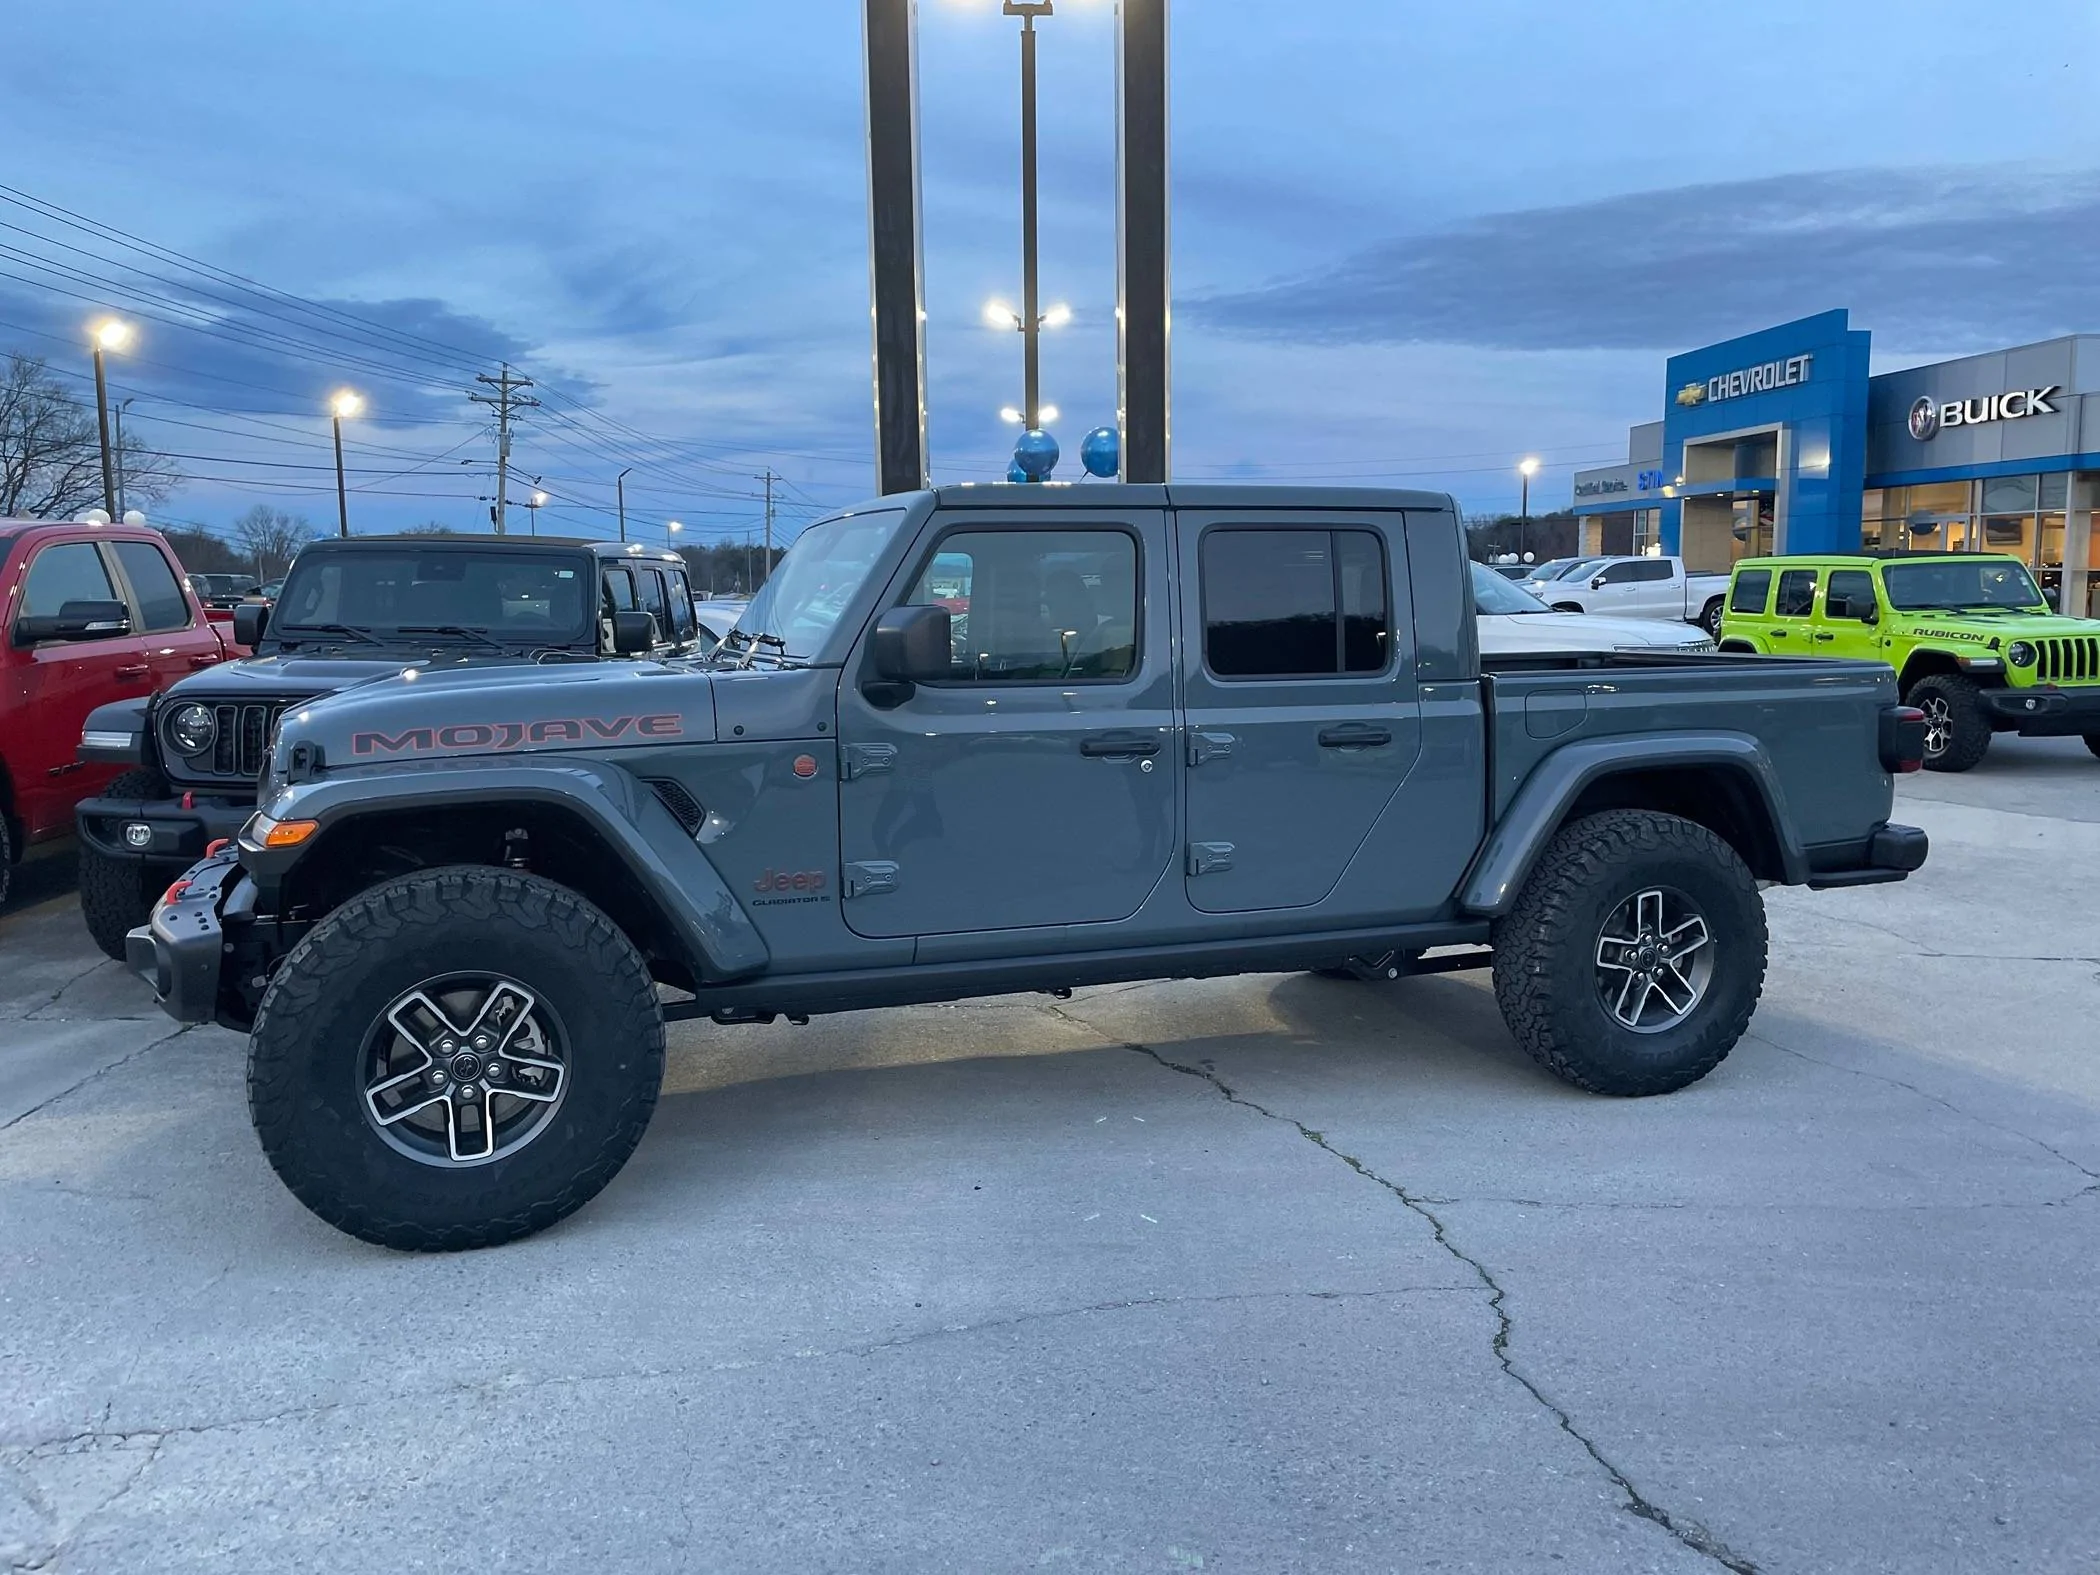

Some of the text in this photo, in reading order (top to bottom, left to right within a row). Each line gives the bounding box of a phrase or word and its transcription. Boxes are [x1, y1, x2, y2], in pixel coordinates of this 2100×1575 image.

[1708, 354, 1809, 402] CHEVROLET
[1939, 384, 2057, 428] BUICK
[1913, 628, 1985, 641] RUBICON
[353, 714, 682, 755] MOJAVE
[753, 867, 827, 893] Jeep
[752, 897, 818, 906] GLADIATOR
